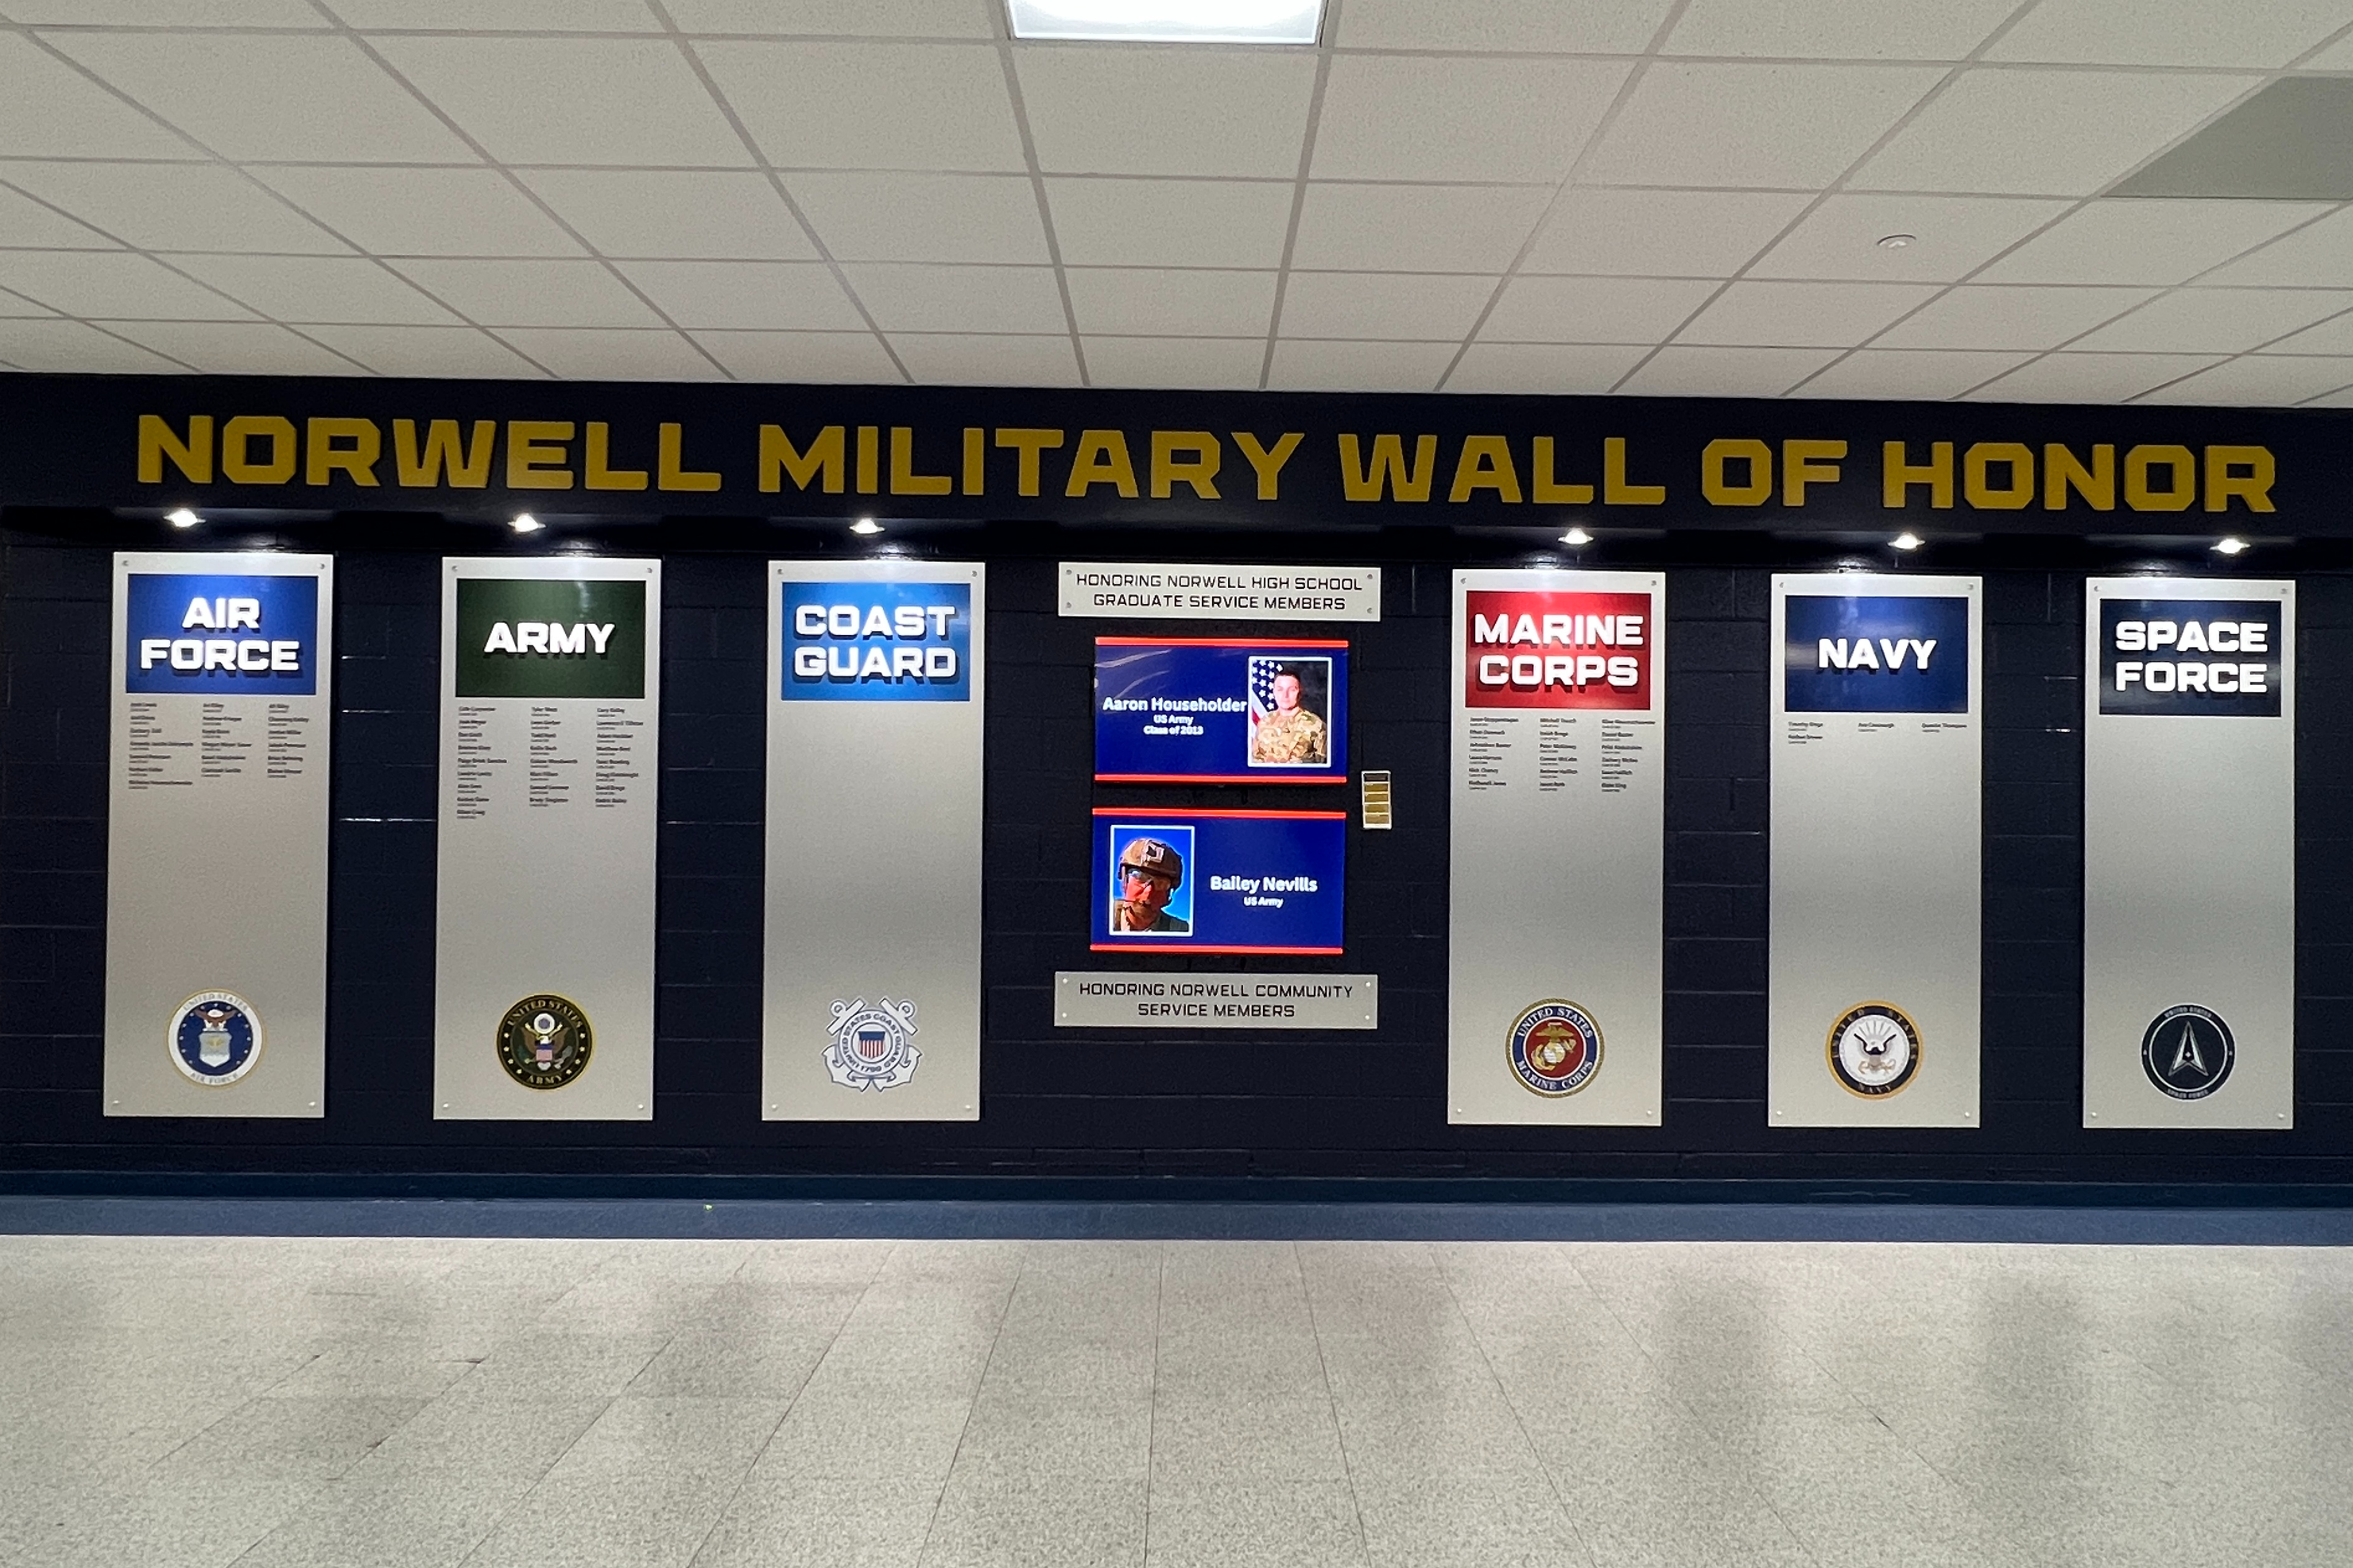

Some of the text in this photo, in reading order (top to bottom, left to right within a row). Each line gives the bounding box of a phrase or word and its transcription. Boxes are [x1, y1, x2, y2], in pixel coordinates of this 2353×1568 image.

[138, 415, 2276, 513] NORWELL MILITARY WALL OF HONOR
[1077, 574, 1363, 590] HONORING NORWELL HIGH SCHOOL
[182, 597, 260, 629] AIR
[1094, 593, 1346, 610] GRADUATE SERVICE MEMBERS
[796, 605, 955, 636] COAST
[1475, 614, 1643, 645] MARINE
[484, 622, 615, 654] ARMY
[2115, 621, 2269, 652] SPACE
[141, 639, 299, 670] FORCE
[794, 647, 956, 677] GUARD
[1819, 638, 1937, 670] NAVY
[1479, 655, 1638, 687] CORPS
[2116, 662, 2268, 693] FORCE
[1103, 697, 1247, 712] Aaron Householder
[1154, 714, 1194, 726] US Army
[1169, 726, 1180, 735] of
[1210, 875, 1318, 894] Bailey Nevills
[1244, 896, 1284, 909] US Army
[1080, 983, 1353, 998] HONORING NORWELL COMMUNITY
[507, 999, 583, 1028] UNITED STATES
[1138, 1003, 1294, 1017] SERVICE MEMBERS
[1517, 1007, 1593, 1038] UNITED STATES
[526, 1075, 562, 1084] ARMY
[1517, 1059, 1593, 1091] MARINE CORPS
